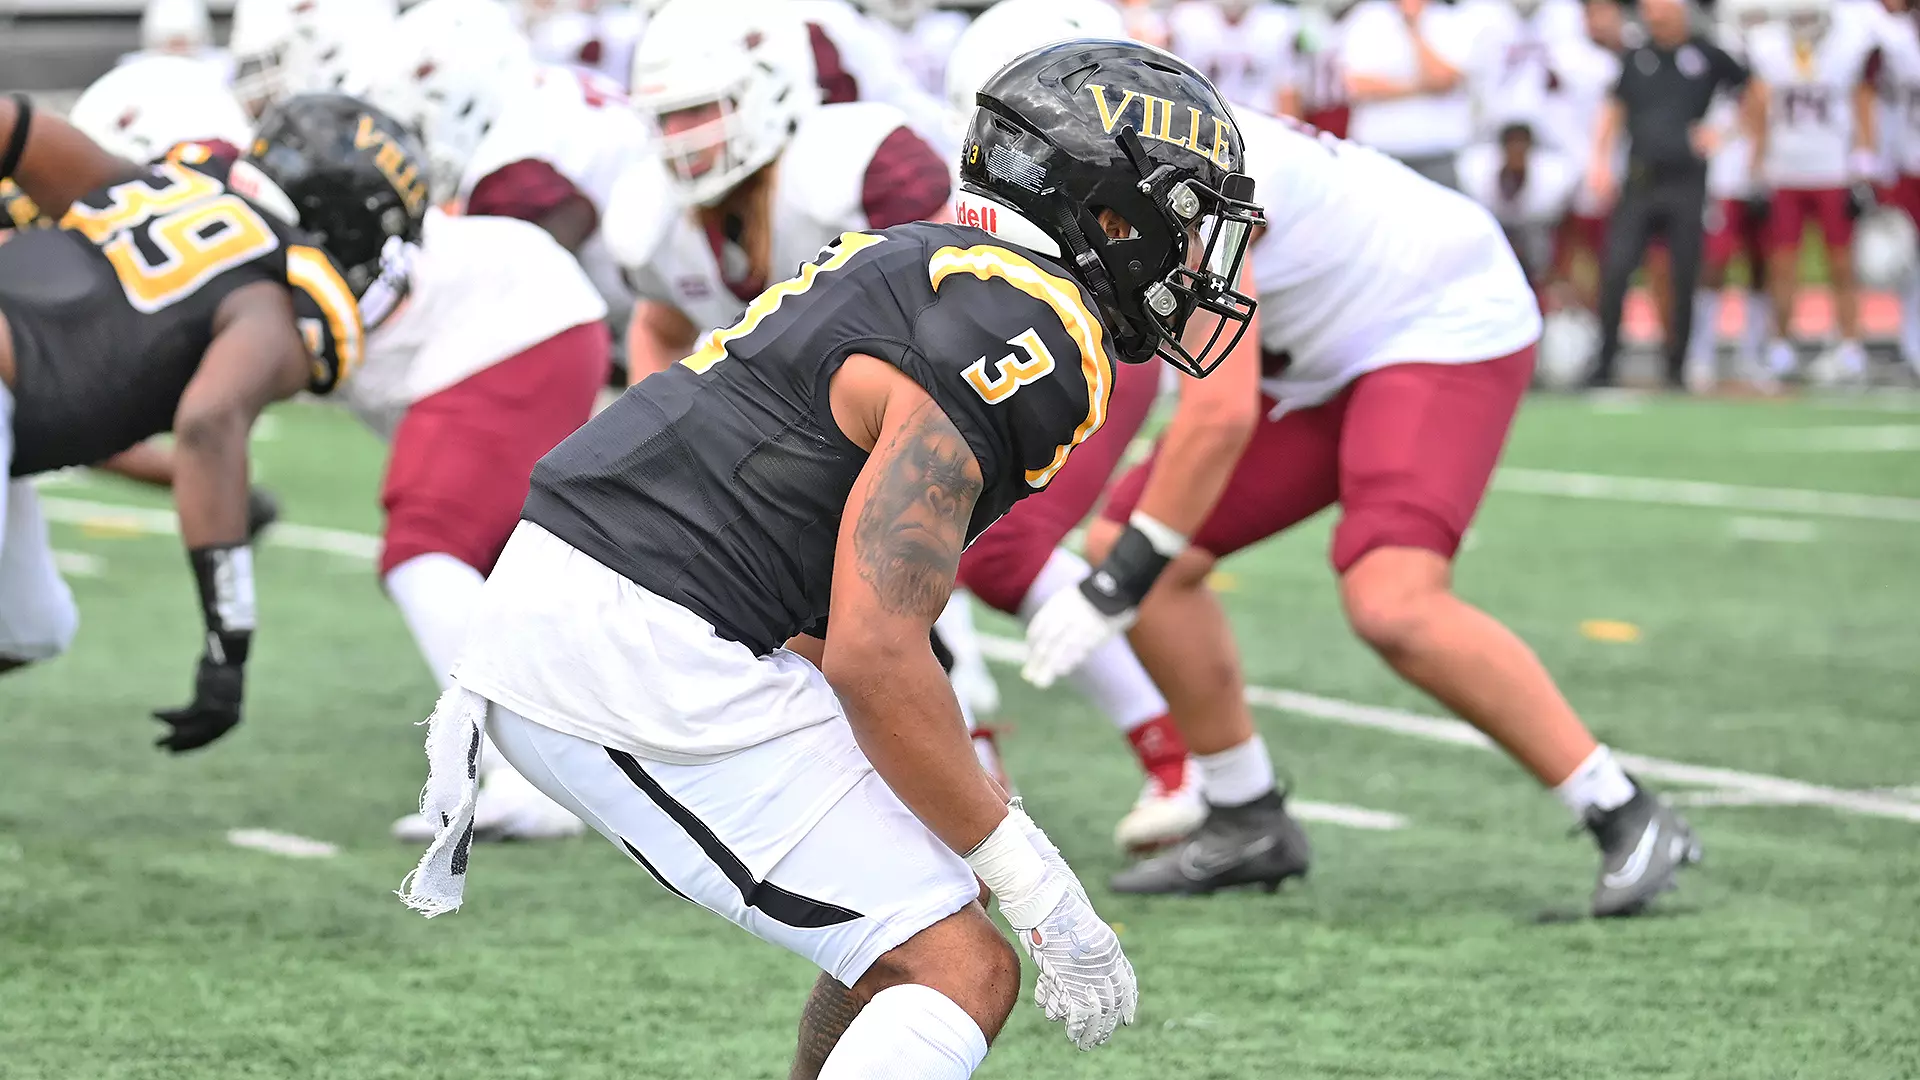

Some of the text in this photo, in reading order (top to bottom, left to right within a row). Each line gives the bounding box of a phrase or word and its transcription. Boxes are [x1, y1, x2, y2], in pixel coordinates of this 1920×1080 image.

[970, 145, 979, 164] 3
[1085, 84, 1231, 171] VILLE
[59, 160, 281, 315] 39
[960, 327, 1056, 405] 3
